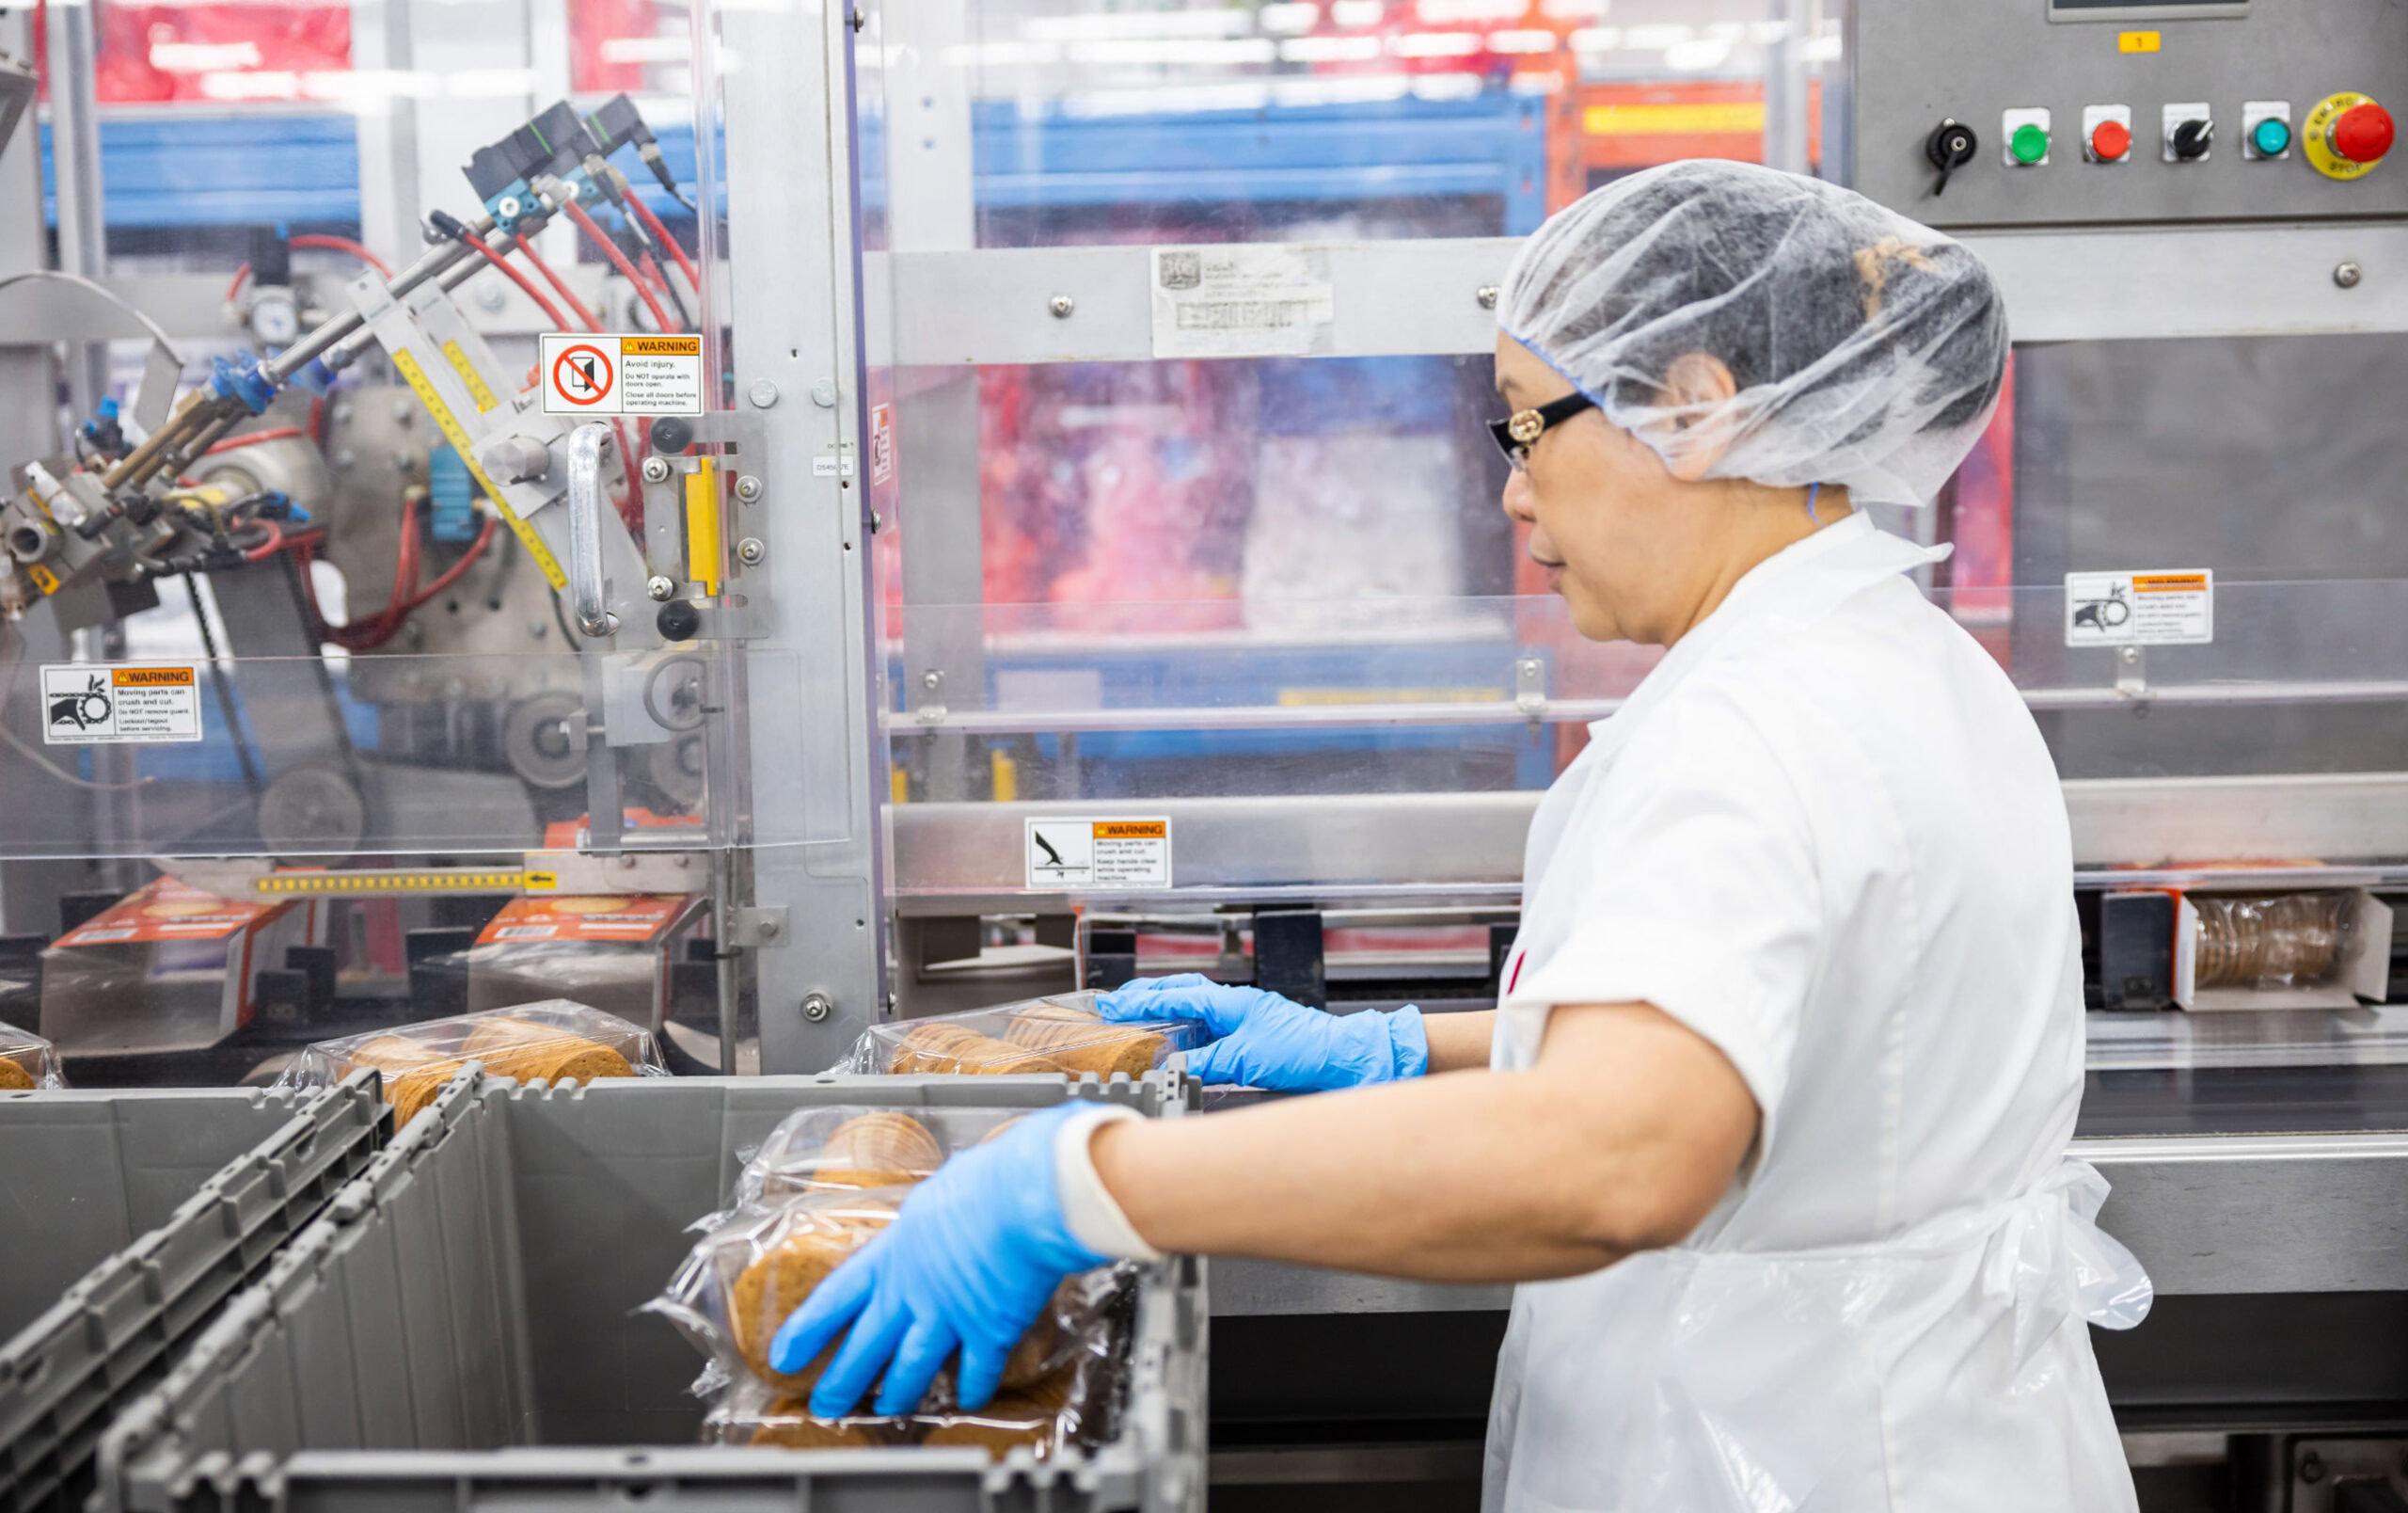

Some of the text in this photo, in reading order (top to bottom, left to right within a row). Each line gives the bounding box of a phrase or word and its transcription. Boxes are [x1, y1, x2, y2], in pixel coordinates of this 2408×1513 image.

[2330, 162, 2363, 173] STOP
[637, 341, 697, 352] WARNING
[625, 359, 676, 369] Avoid injury.
[626, 399, 657, 407] operating
[128, 671, 190, 683] WARNING
[118, 689, 147, 697] Moving
[148, 689, 169, 697] parts
[1108, 825, 1163, 835] WARNING
